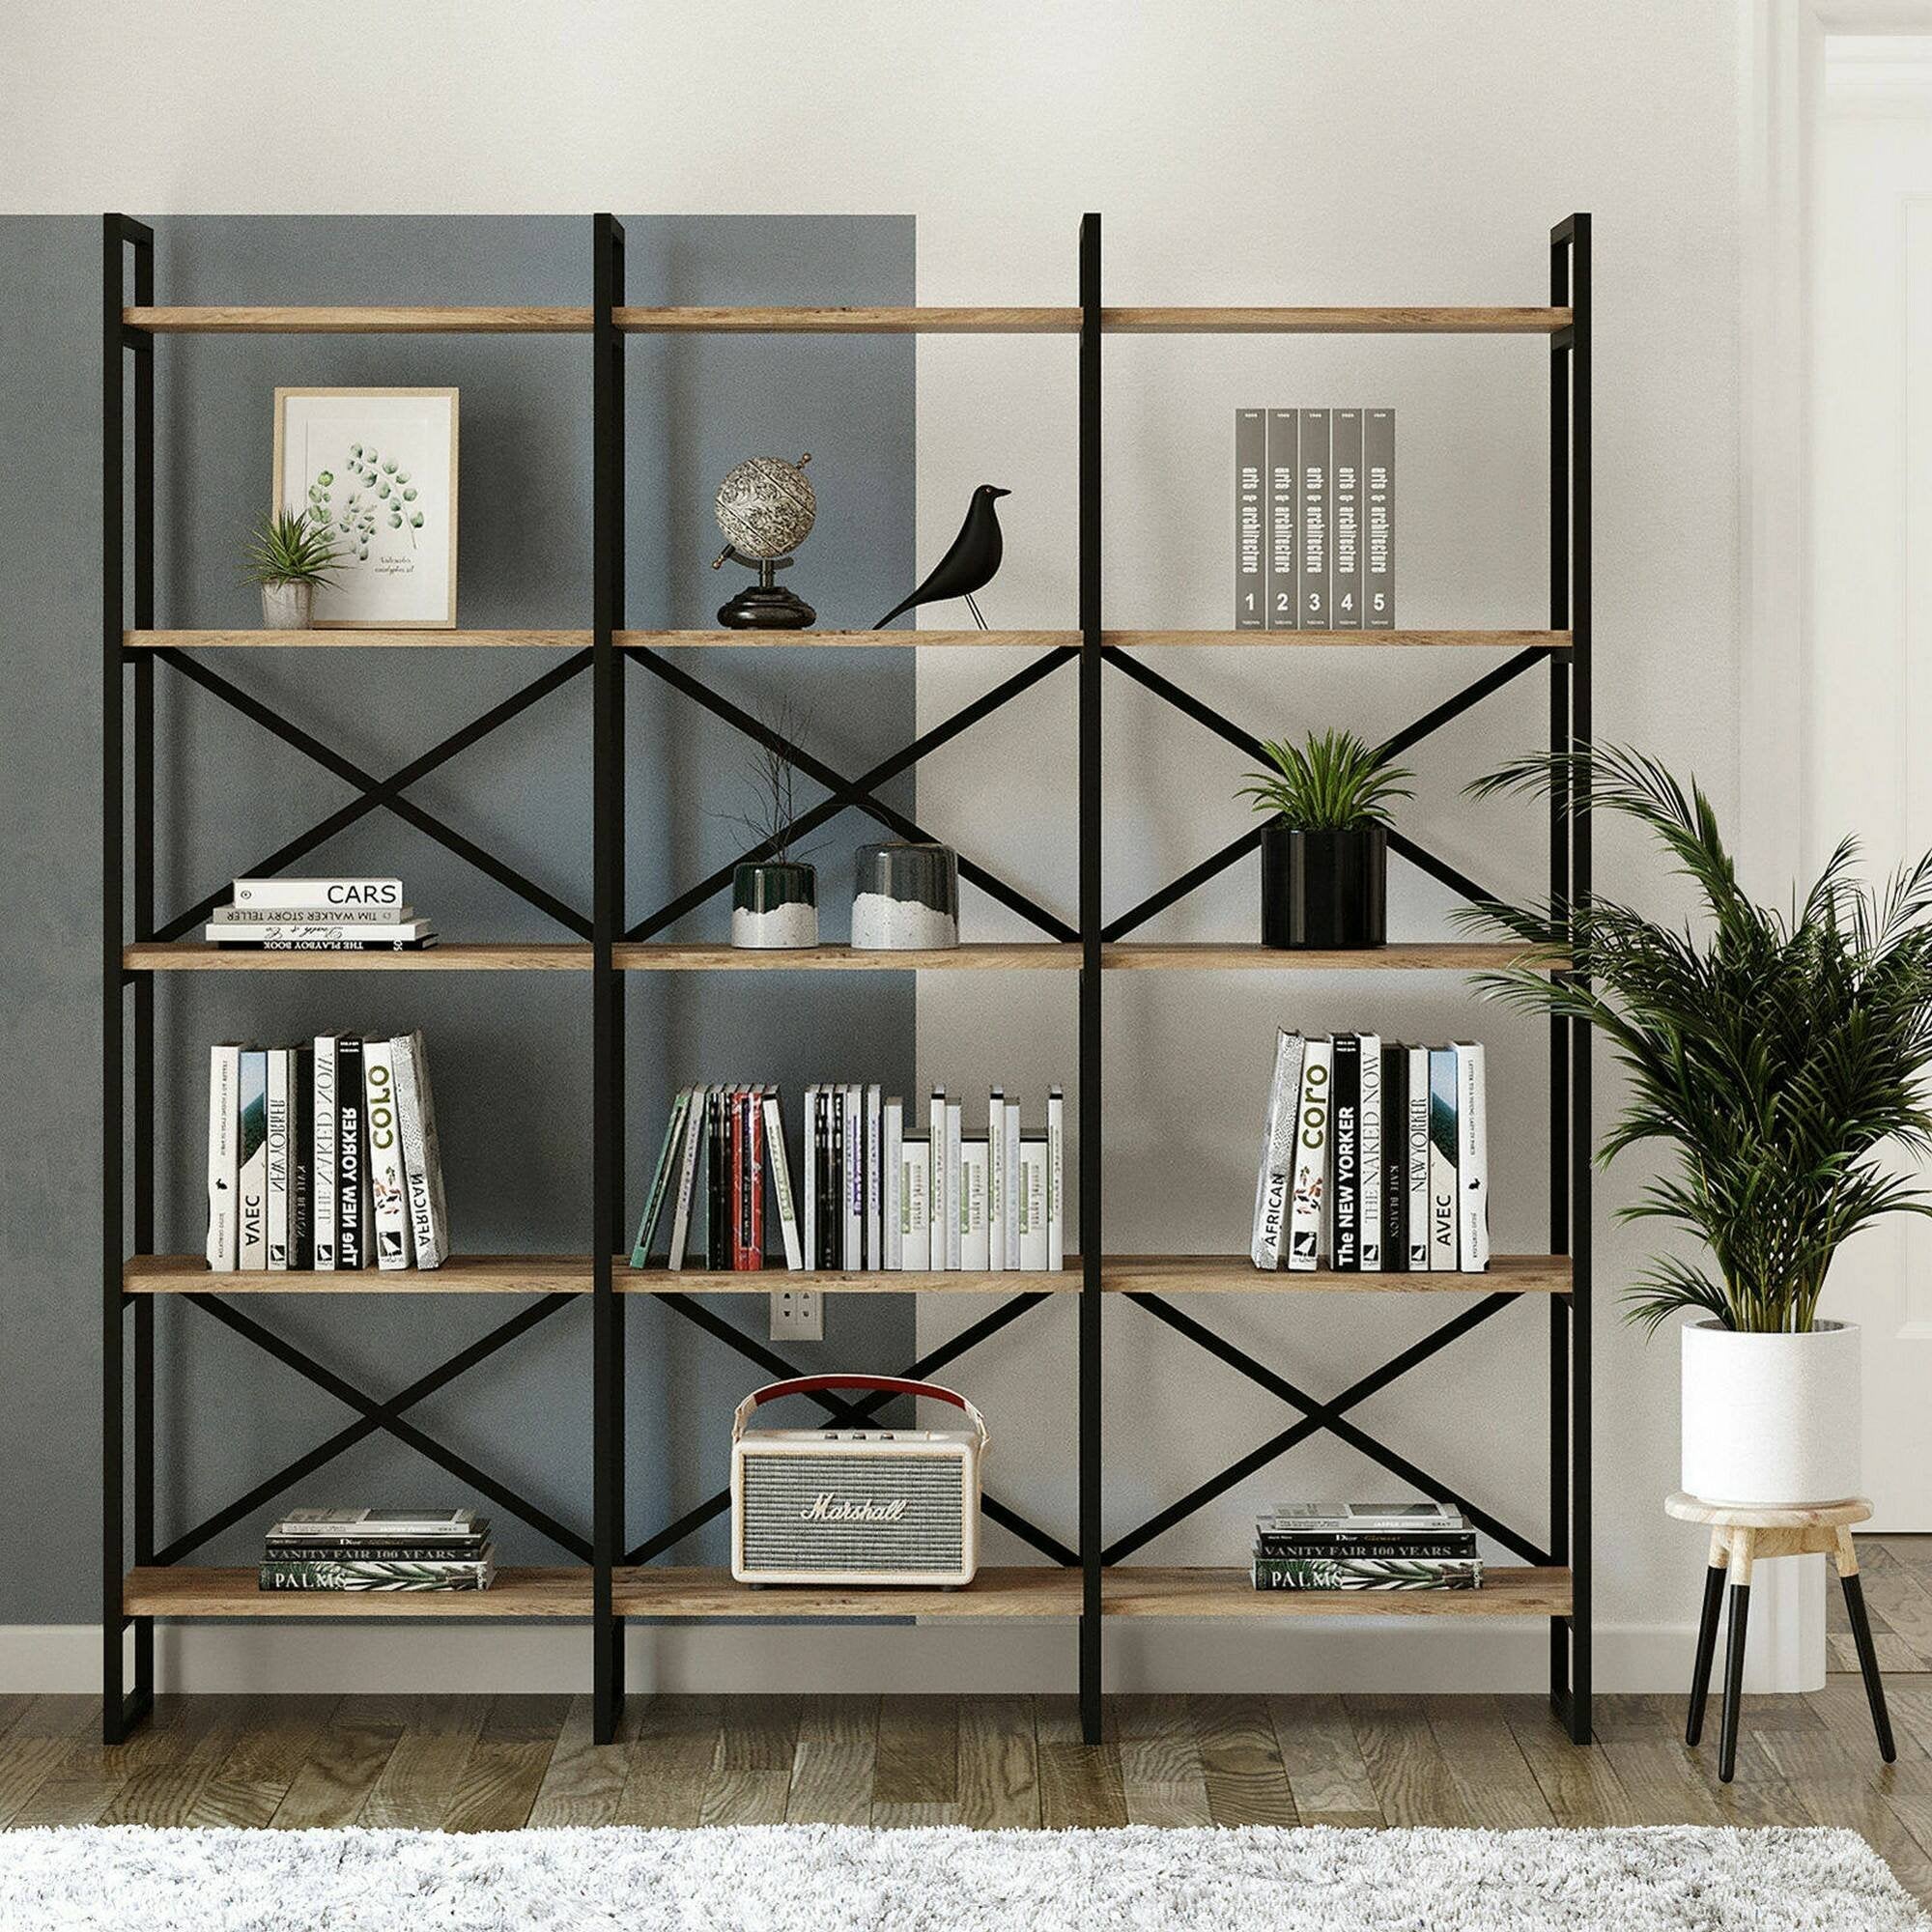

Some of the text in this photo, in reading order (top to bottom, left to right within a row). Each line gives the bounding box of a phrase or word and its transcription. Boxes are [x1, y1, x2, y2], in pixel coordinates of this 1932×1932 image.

[1242, 468, 1260, 489] arts
[1274, 468, 1292, 489] arts
[1307, 468, 1324, 489] arts
[1339, 468, 1356, 489] arts
[1372, 468, 1389, 489] arts
[1242, 506, 1261, 574] architecture
[1274, 506, 1293, 574] architecture
[1307, 506, 1325, 574] architecture
[1339, 506, 1357, 574] architecture
[1372, 506, 1390, 574] architecture
[1245, 593, 1254, 611] 1
[1277, 593, 1289, 611] 2
[1309, 593, 1321, 611] 3
[1341, 593, 1352, 611] 4
[1374, 593, 1385, 611] 5
[327, 885, 396, 904] CARS
[226, 911, 377, 921] TIM WALKER STORY TELLER
[263, 941, 363, 950] THE PLAYBOY BOOK
[1303, 1065, 1327, 1150] coro
[1363, 1053, 1379, 1224] THE NAKED NOW
[1410, 1098, 1428, 1192] NEW YORKER
[1337, 1106, 1354, 1266] The NEW YORKER
[1264, 1173, 1285, 1247] AFRICAN
[1436, 1195, 1451, 1246] AVEC
[800, 1492, 910, 1521] Marshall
[269, 1549, 456, 1559] VANITY FAIR 100 YEARS
[1264, 1547, 1451, 1556] VANITY FAIR 100 YEARS
[275, 1573, 347, 1588] PALMS
[1271, 1572, 1345, 1587] PALMS
